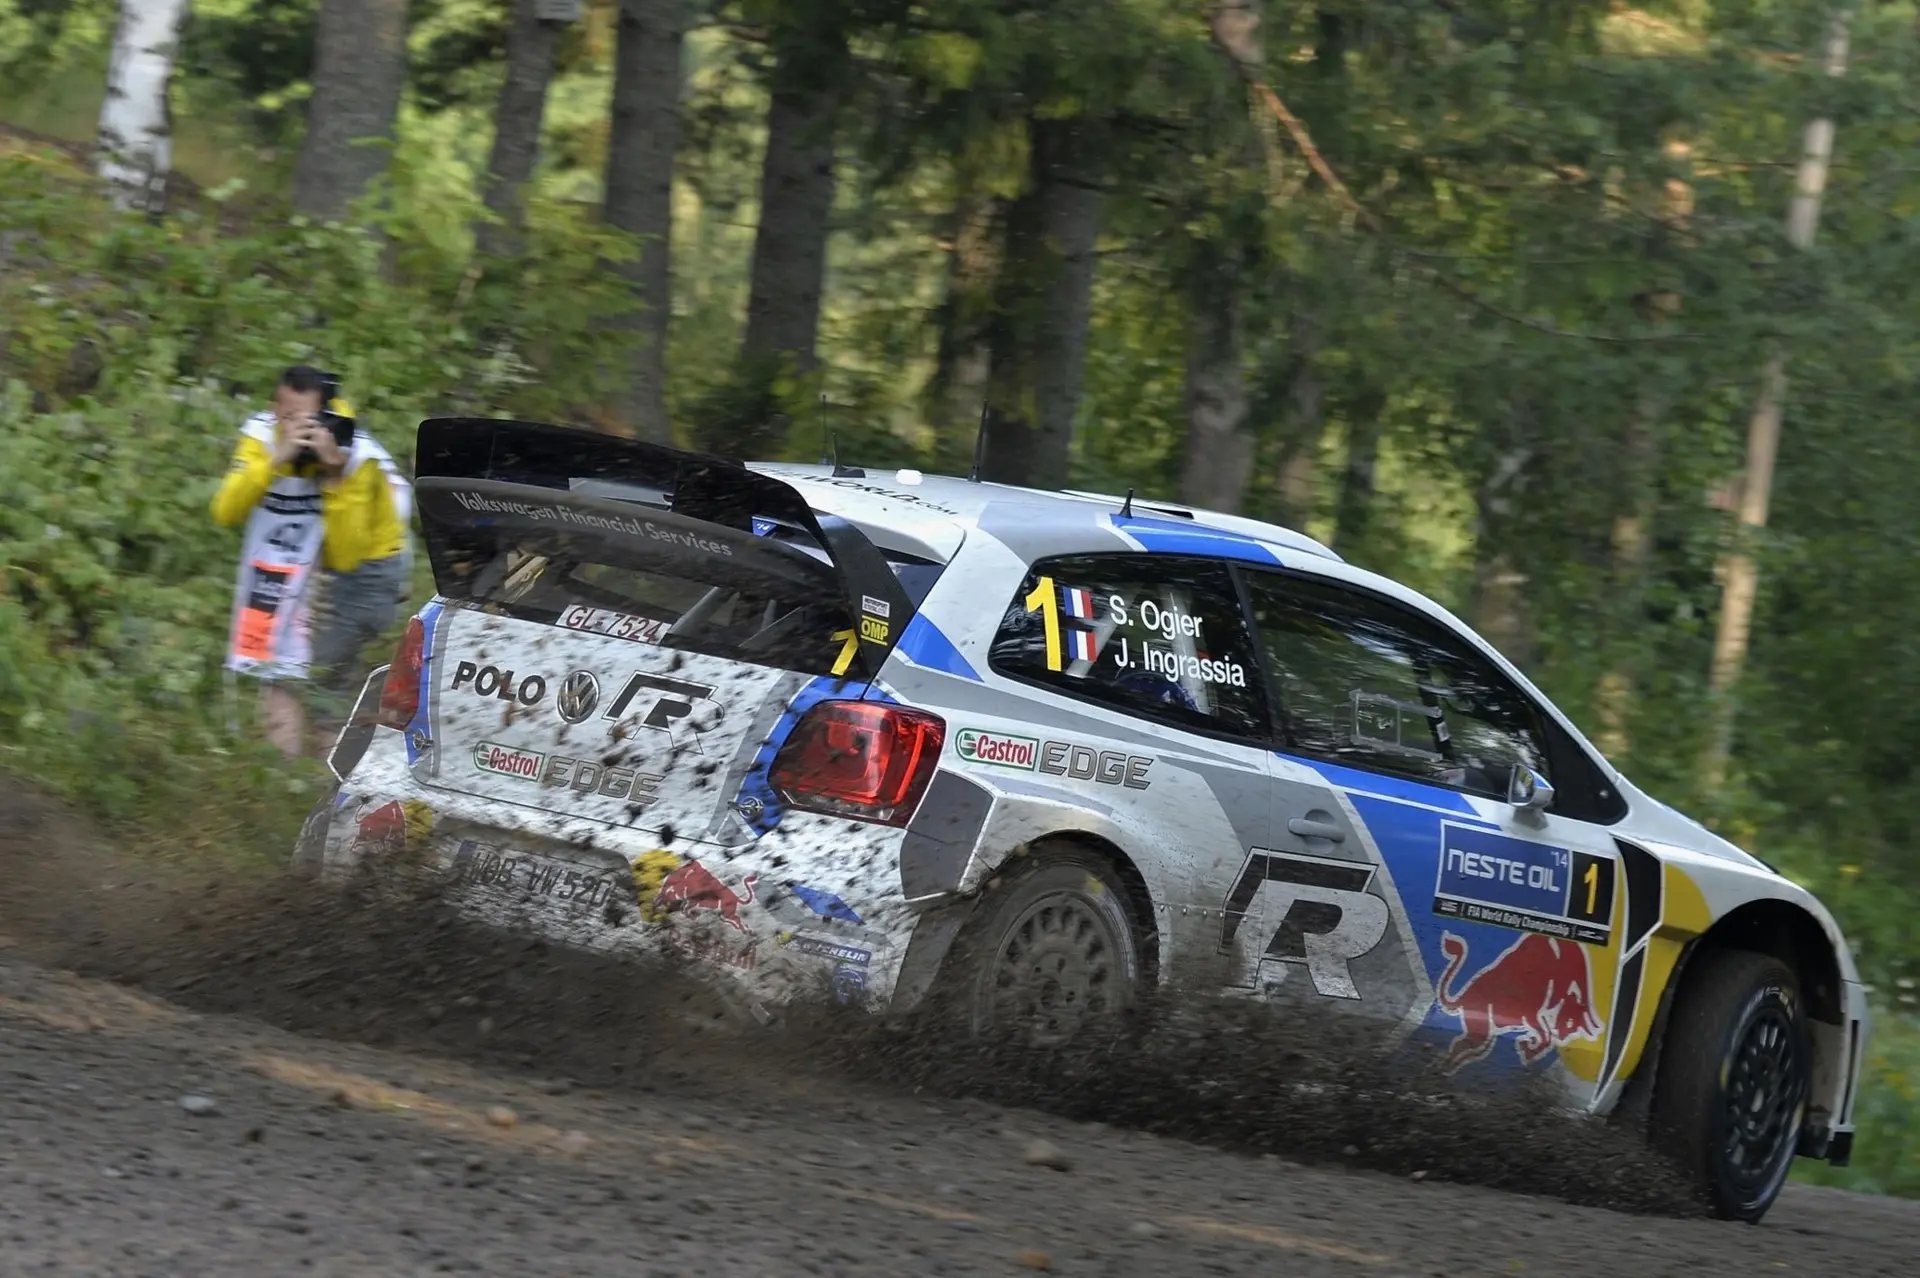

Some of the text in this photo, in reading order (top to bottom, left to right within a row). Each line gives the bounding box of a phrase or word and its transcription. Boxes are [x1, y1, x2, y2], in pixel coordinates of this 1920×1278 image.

[452, 491, 733, 557] Volkswagen Financial Services
[861, 619, 889, 641] OMP
[1026, 577, 1062, 672] 1
[1109, 595, 1203, 640] S. Ogier
[451, 660, 547, 706] POLO
[1114, 637, 1246, 687] J. Ingrassia
[489, 746, 666, 805] Castrol EDGE
[976, 734, 1154, 790] Castrol EDGE
[1528, 865, 1560, 892] OIL
[1583, 862, 1599, 914] 1
[1216, 846, 1390, 1001] R
[1467, 904, 1481, 918] FIA
[1481, 907, 1502, 922] World
[1503, 911, 1522, 928] Rally
[1523, 915, 1570, 938] Championship
